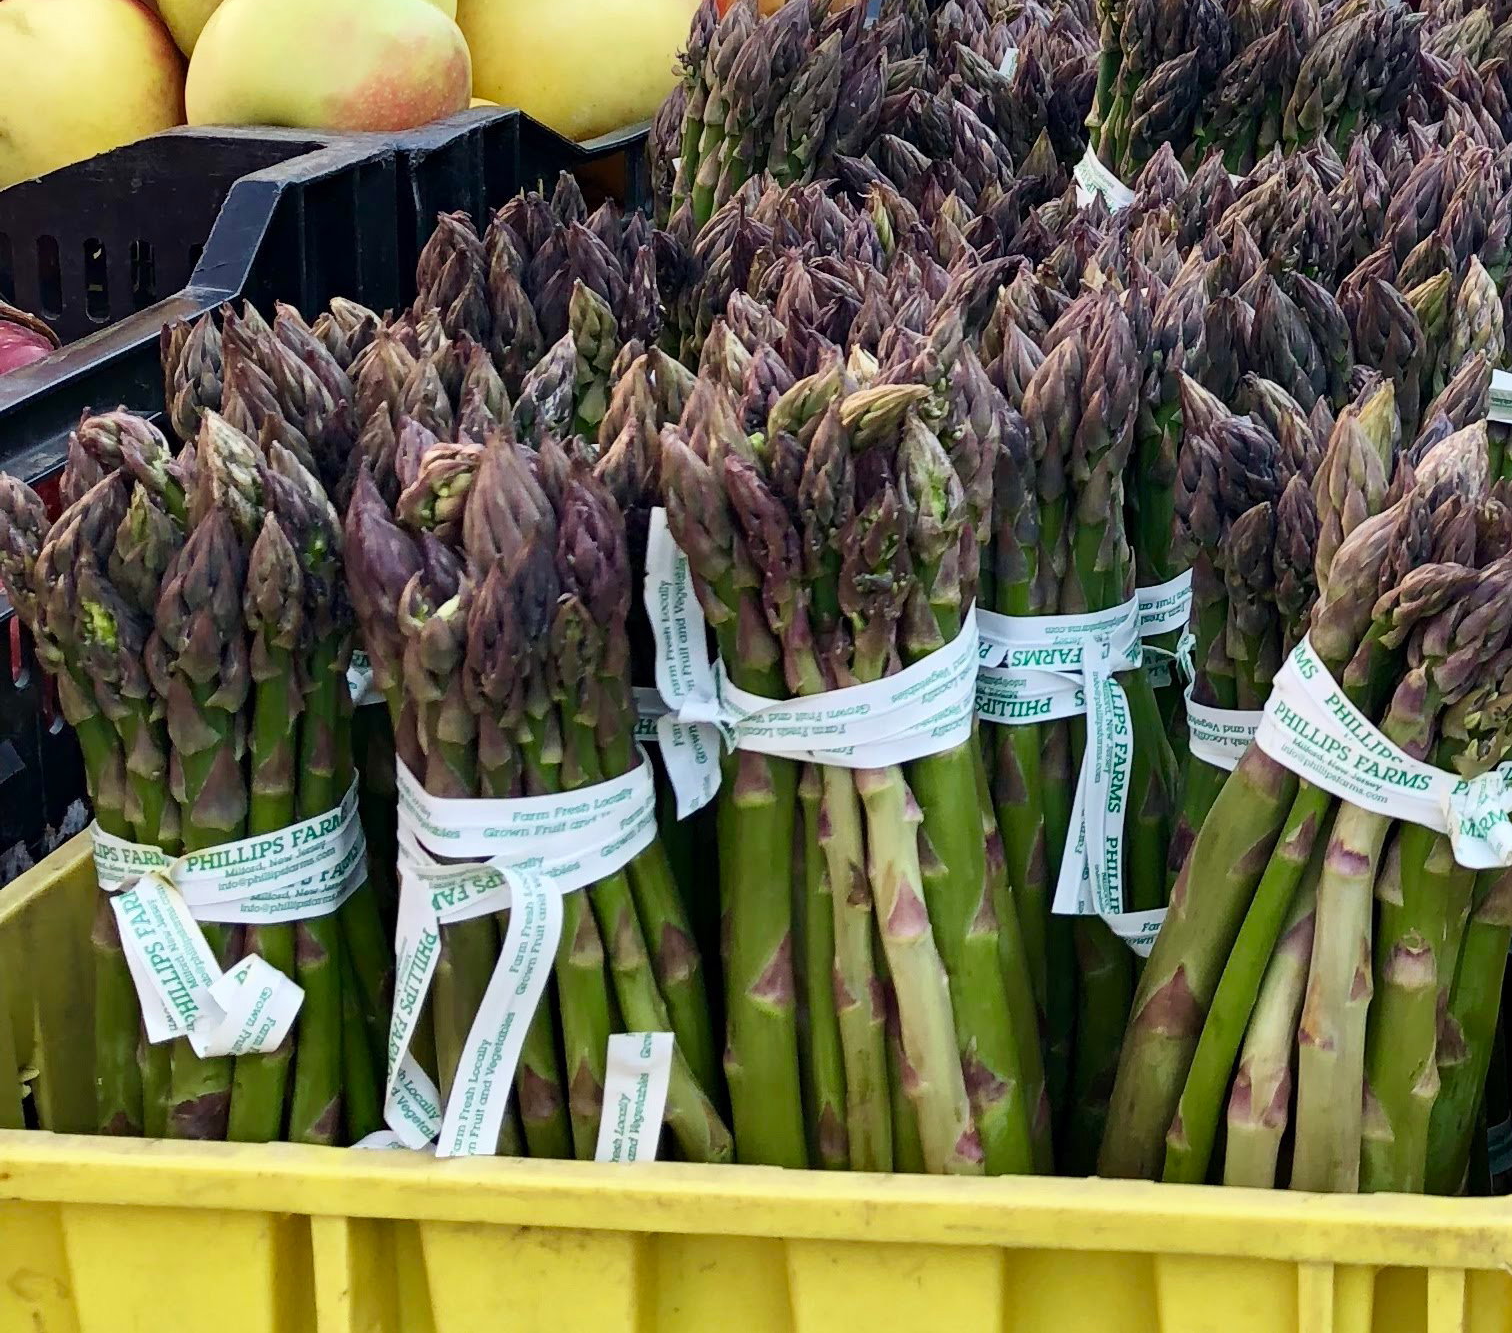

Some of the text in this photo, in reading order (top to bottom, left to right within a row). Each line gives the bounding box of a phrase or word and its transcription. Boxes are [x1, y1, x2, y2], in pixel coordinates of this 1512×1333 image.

[658, 580, 671, 622] Locally
[664, 626, 677, 662] Fresh
[676, 619, 688, 645] and
[1011, 648, 1083, 666] FARMS
[769, 712, 792, 724] and
[827, 704, 871, 718] Grown
[976, 695, 1053, 717] PHILLIPS
[1224, 725, 1245, 735] and
[1271, 700, 1433, 791] PHILLIPS FARMS
[1106, 742, 1128, 813] FARMS
[1280, 743, 1388, 804] info@phillipsfarms.com
[1292, 738, 1383, 791] Milford, New Jersey
[512, 787, 633, 822] Farm Fresh Locally
[483, 821, 567, 838] Grown Fruit
[186, 835, 283, 873] PHILLIPS
[218, 845, 336, 892] info@phillipsfarms.com
[224, 840, 327, 880] Milford, New Jersey
[147, 898, 164, 925] Jersey
[294, 887, 318, 898] New
[161, 927, 178, 952] New
[509, 901, 534, 974] Farm Fresh
[515, 891, 547, 996] Grown Fruit and
[399, 926, 437, 1015] PHILLIPS
[249, 986, 273, 1024] Grown
[255, 1016, 276, 1048] Farm
[458, 1038, 492, 1122] Fresh Locally
[469, 1011, 516, 1140] Fruit and Vegetables
[403, 1075, 441, 1119] Locally
[614, 1093, 631, 1130] Locally
[627, 1071, 649, 1157] and Vegetables
